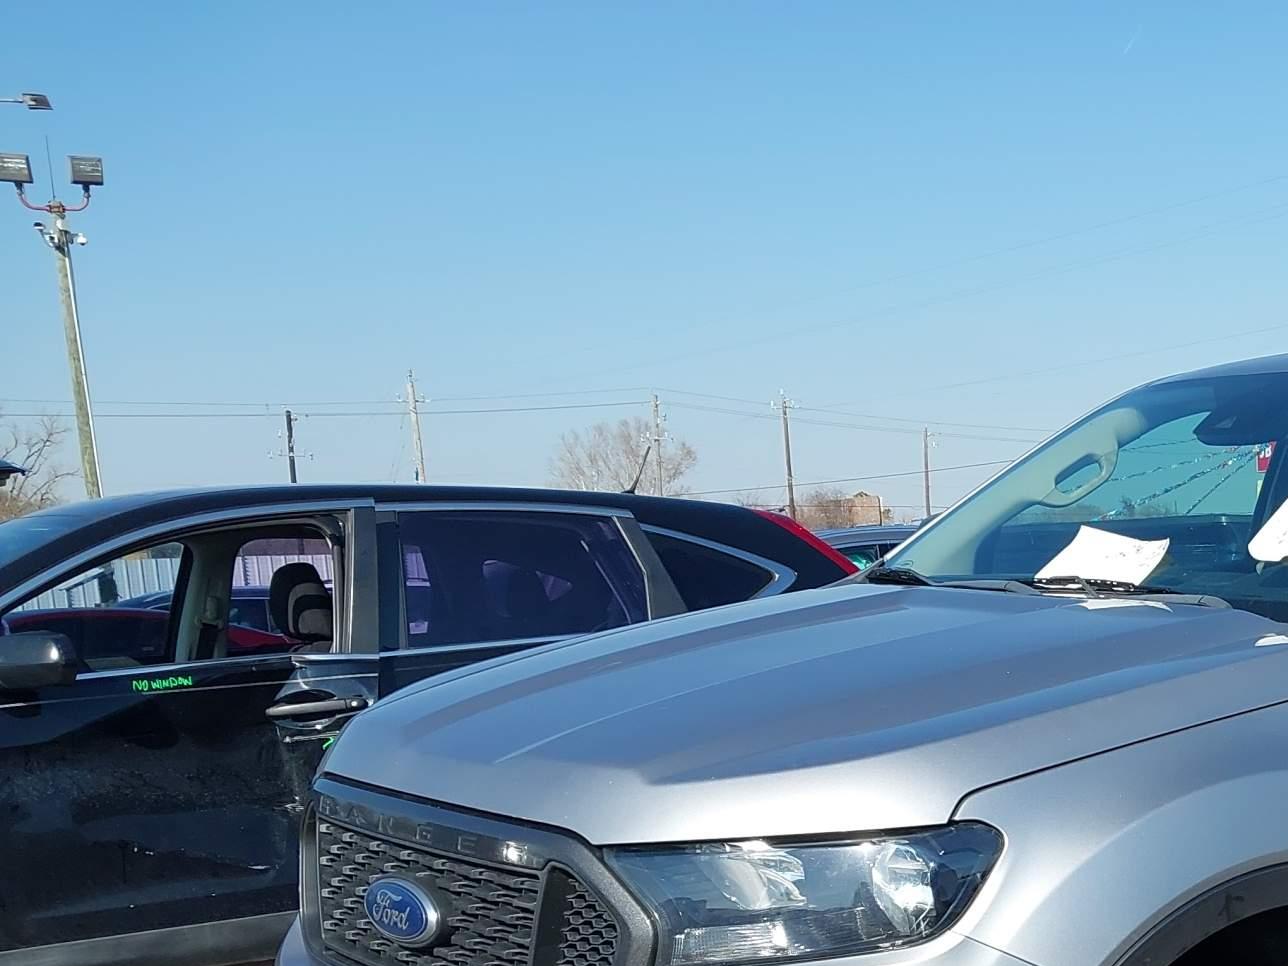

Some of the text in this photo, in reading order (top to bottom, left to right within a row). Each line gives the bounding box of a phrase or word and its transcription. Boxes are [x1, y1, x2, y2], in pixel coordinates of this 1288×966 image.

[132, 676, 193, 692] NO WINDOW
[319, 795, 540, 867] RANGER
[371, 888, 411, 931] Ford
